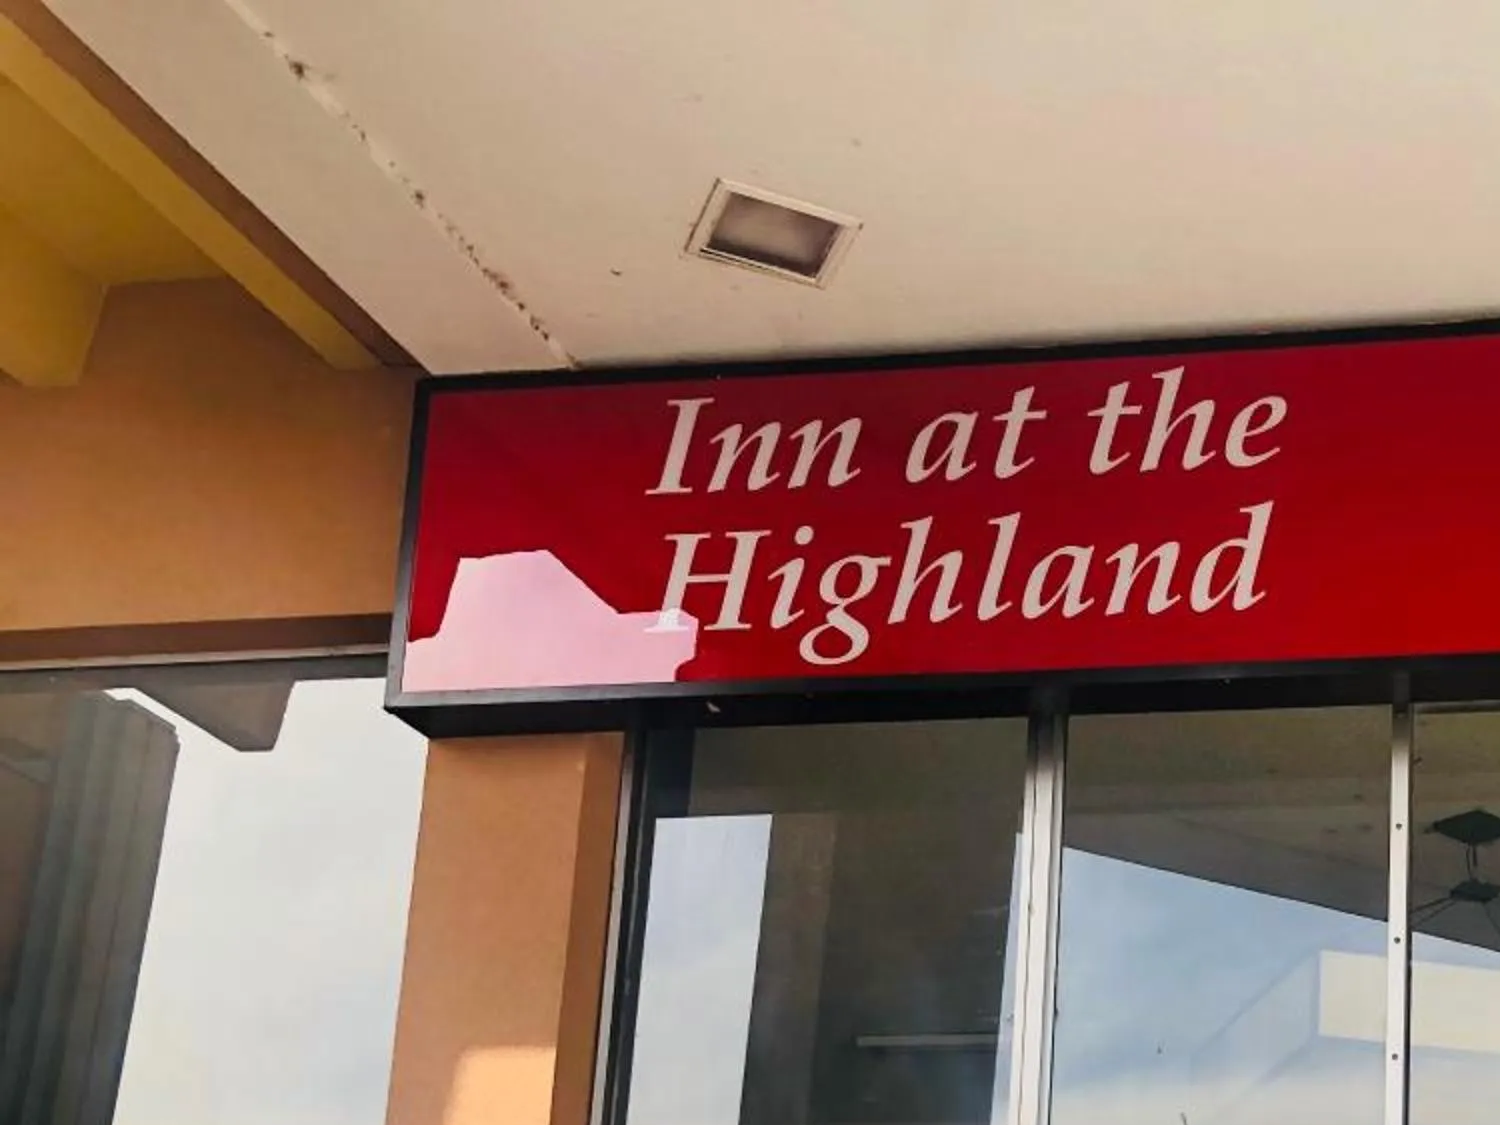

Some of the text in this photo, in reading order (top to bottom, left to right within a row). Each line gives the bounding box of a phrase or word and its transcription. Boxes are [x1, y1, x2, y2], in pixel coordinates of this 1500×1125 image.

[645, 366, 1287, 495] Inn at the
[646, 500, 1274, 665] Highland
